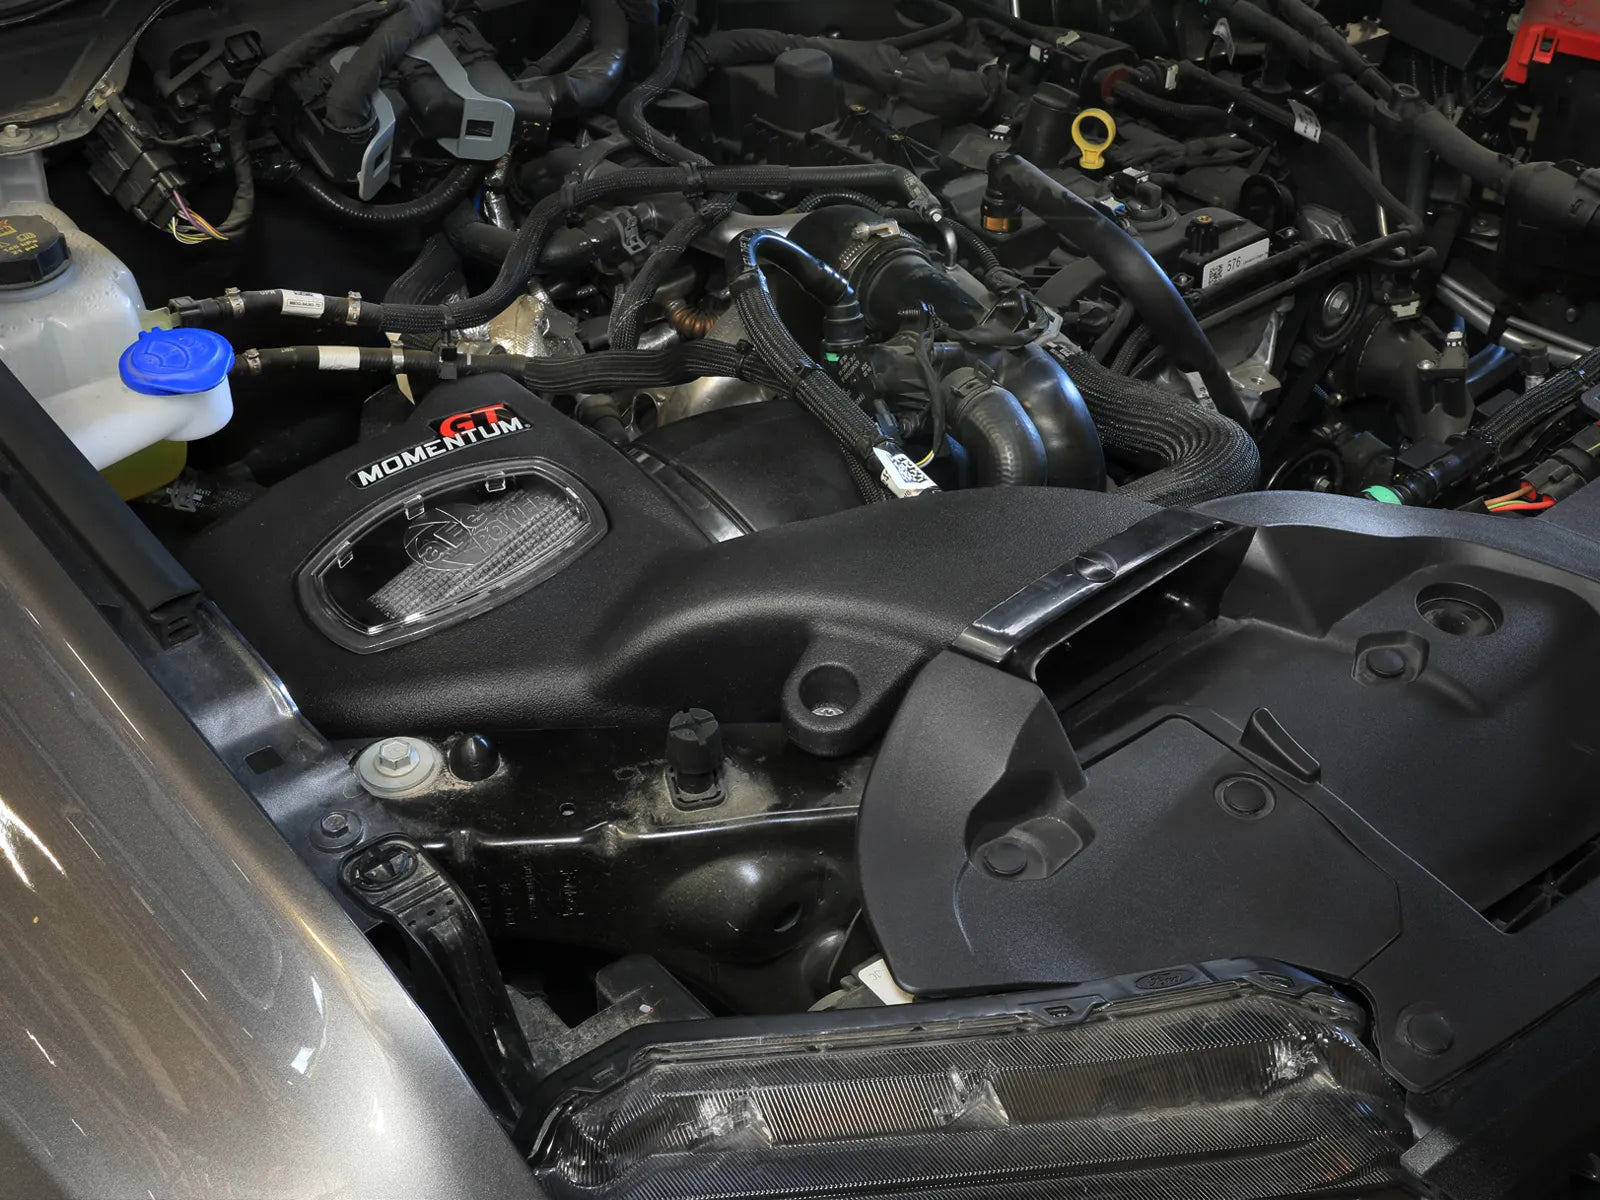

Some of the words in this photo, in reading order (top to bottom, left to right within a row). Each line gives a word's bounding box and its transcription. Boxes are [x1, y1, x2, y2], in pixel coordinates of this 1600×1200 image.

[1226, 256, 1241, 272] 576
[439, 403, 504, 438] GT
[356, 416, 523, 487] MOMENTUM
